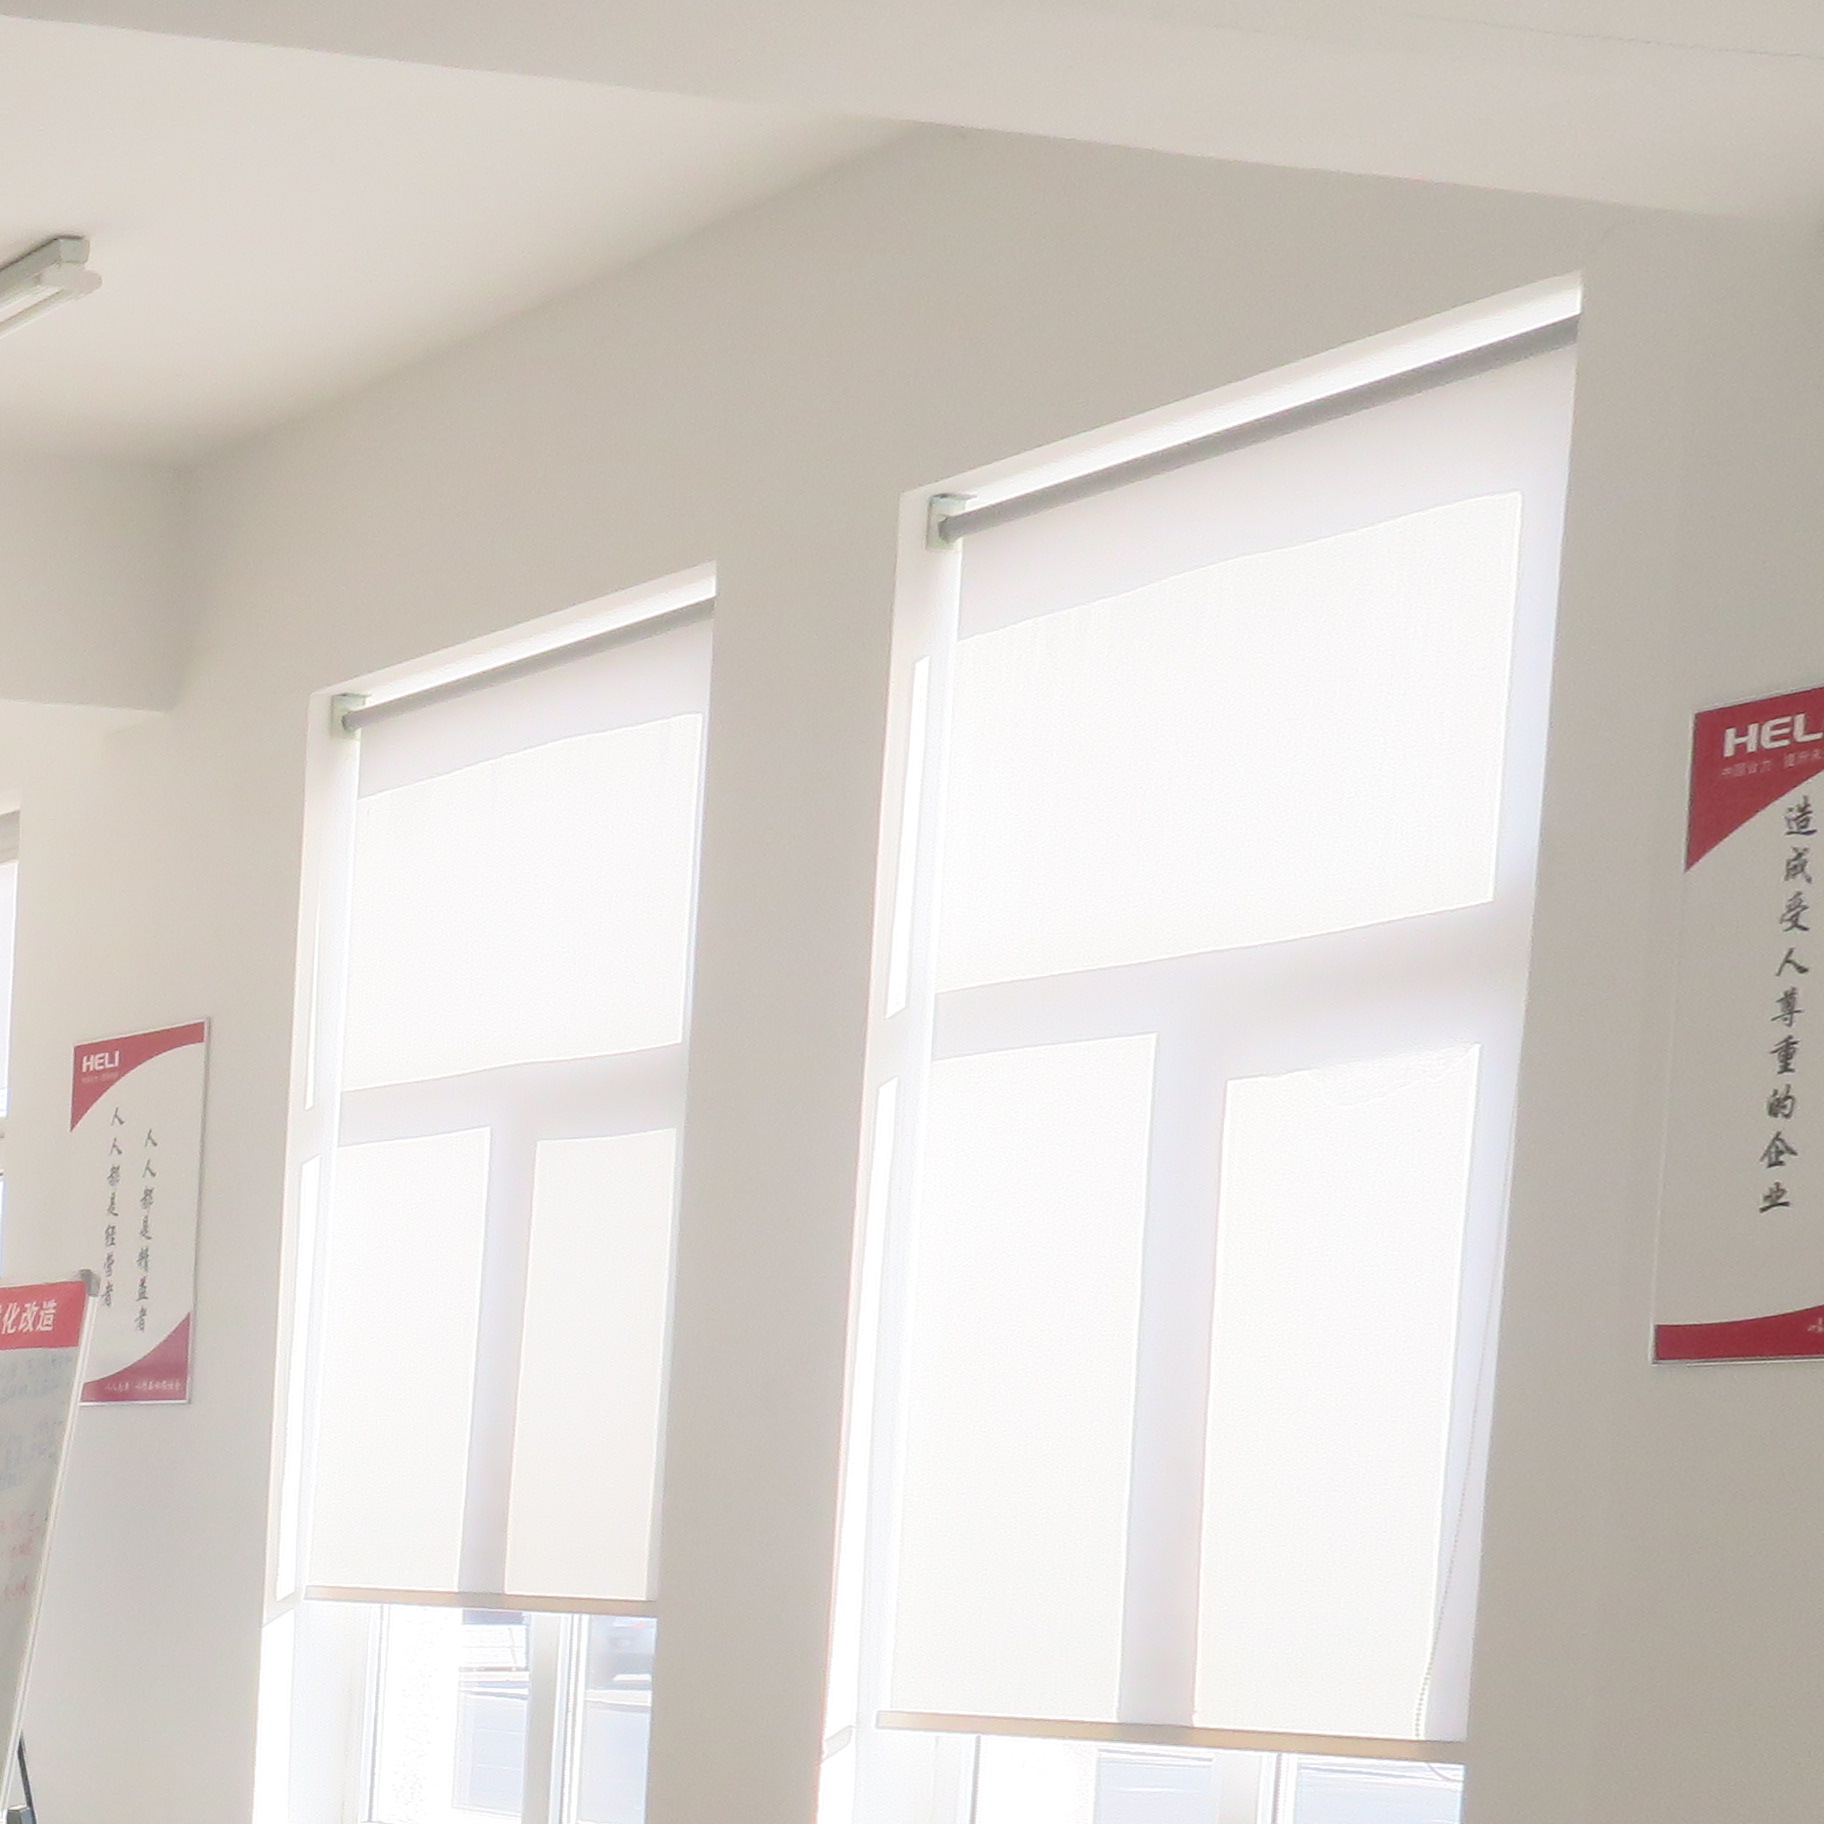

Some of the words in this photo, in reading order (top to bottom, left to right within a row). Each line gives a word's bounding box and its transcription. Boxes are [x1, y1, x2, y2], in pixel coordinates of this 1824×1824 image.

[82, 1050, 120, 1073] HELI
[1759, 795, 1817, 1213] 造成受人尊重的企业
